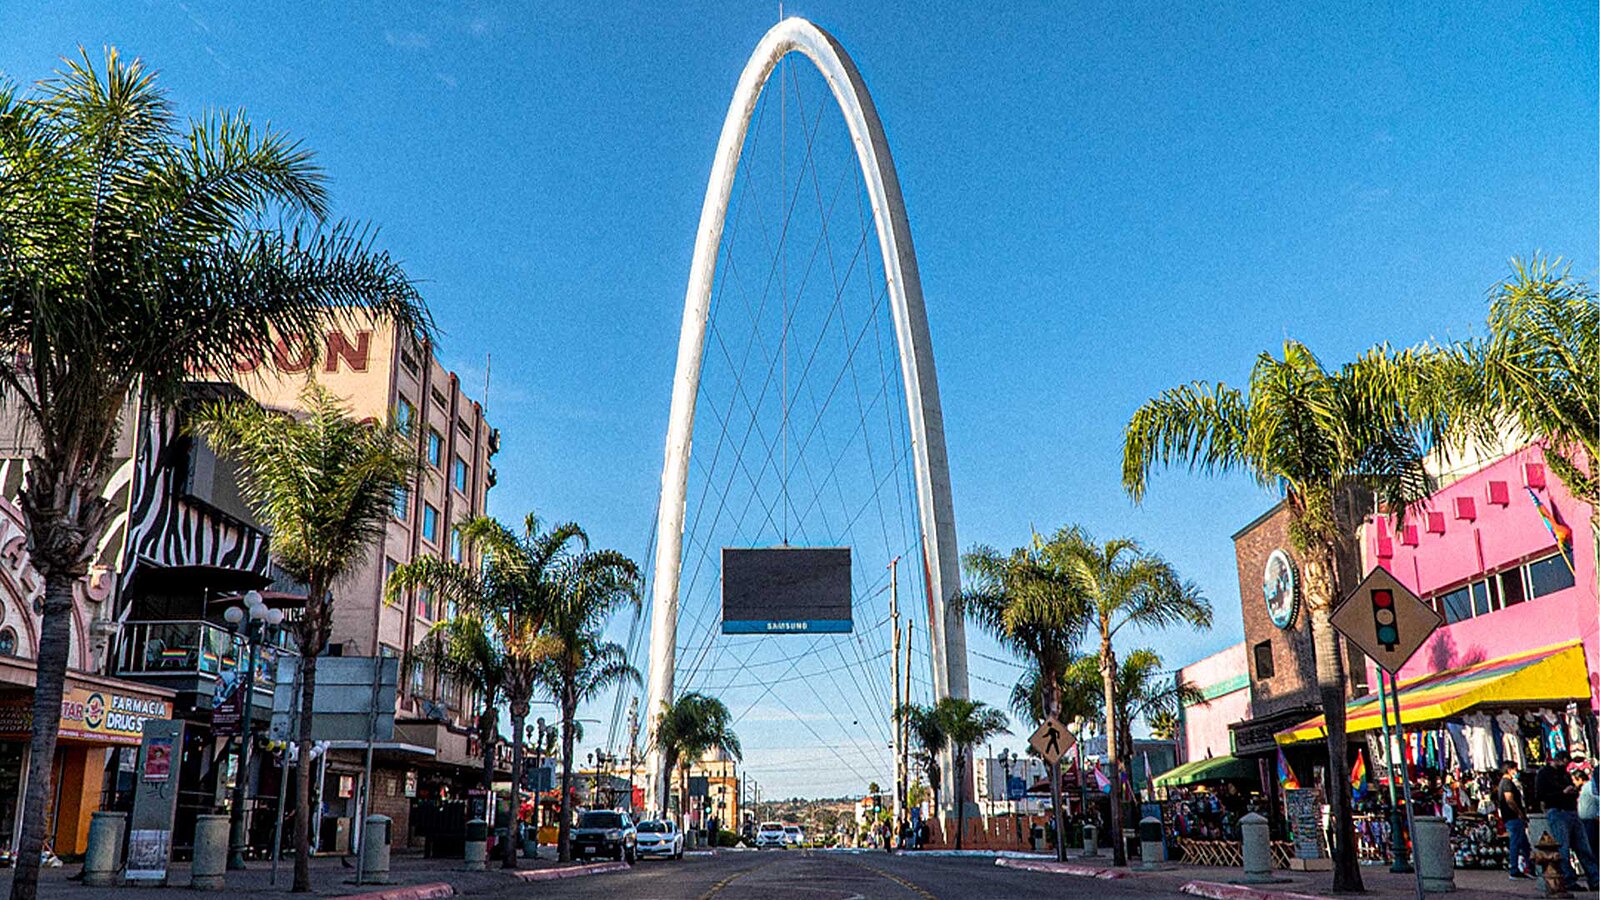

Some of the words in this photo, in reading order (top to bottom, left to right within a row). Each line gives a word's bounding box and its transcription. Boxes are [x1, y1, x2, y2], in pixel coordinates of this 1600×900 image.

[767, 622, 808, 630] SAMSUNG
[111, 695, 166, 716] FARMACIA
[106, 711, 136, 731] DRUG
